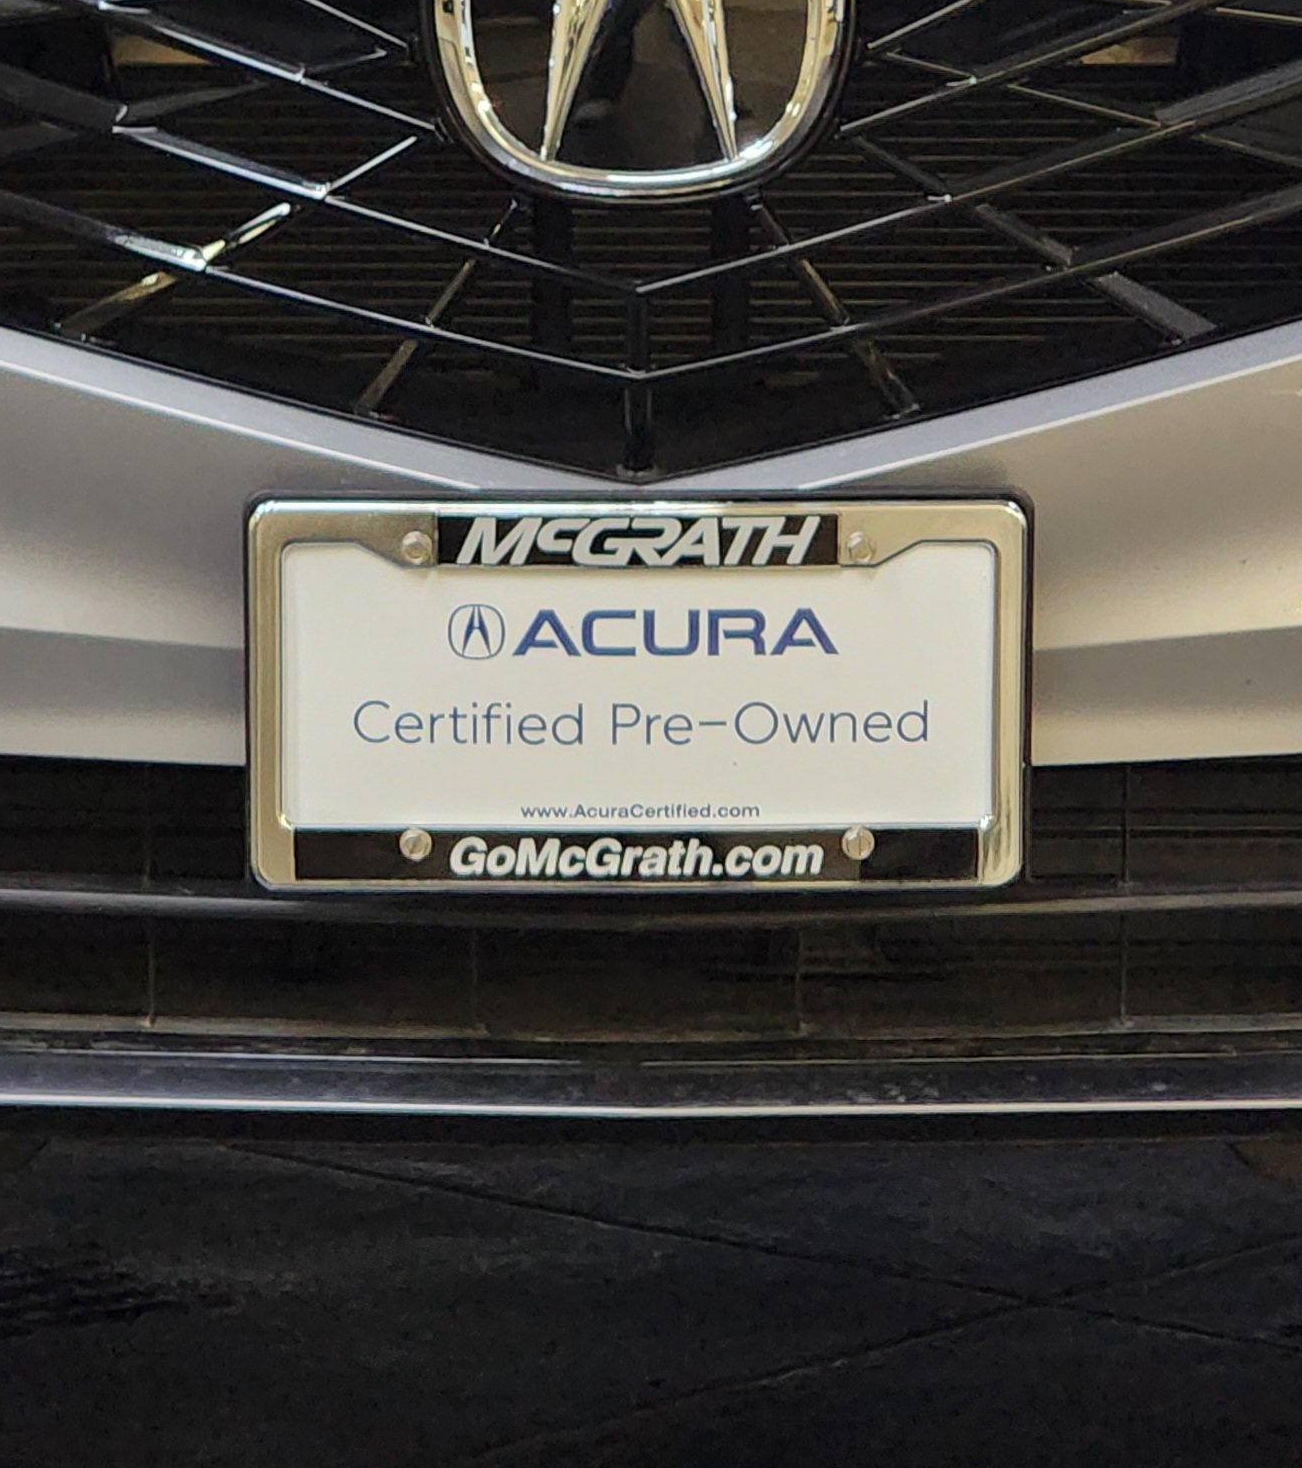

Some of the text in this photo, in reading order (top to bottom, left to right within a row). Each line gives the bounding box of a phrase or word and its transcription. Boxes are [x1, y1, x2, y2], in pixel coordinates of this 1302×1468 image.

[513, 608, 839, 656] ACURA
[353, 700, 930, 745] Certified Pre-Owned
[520, 803, 761, 819] www.AcuraCertified.com
[450, 836, 824, 876] GoMcGrath.com
